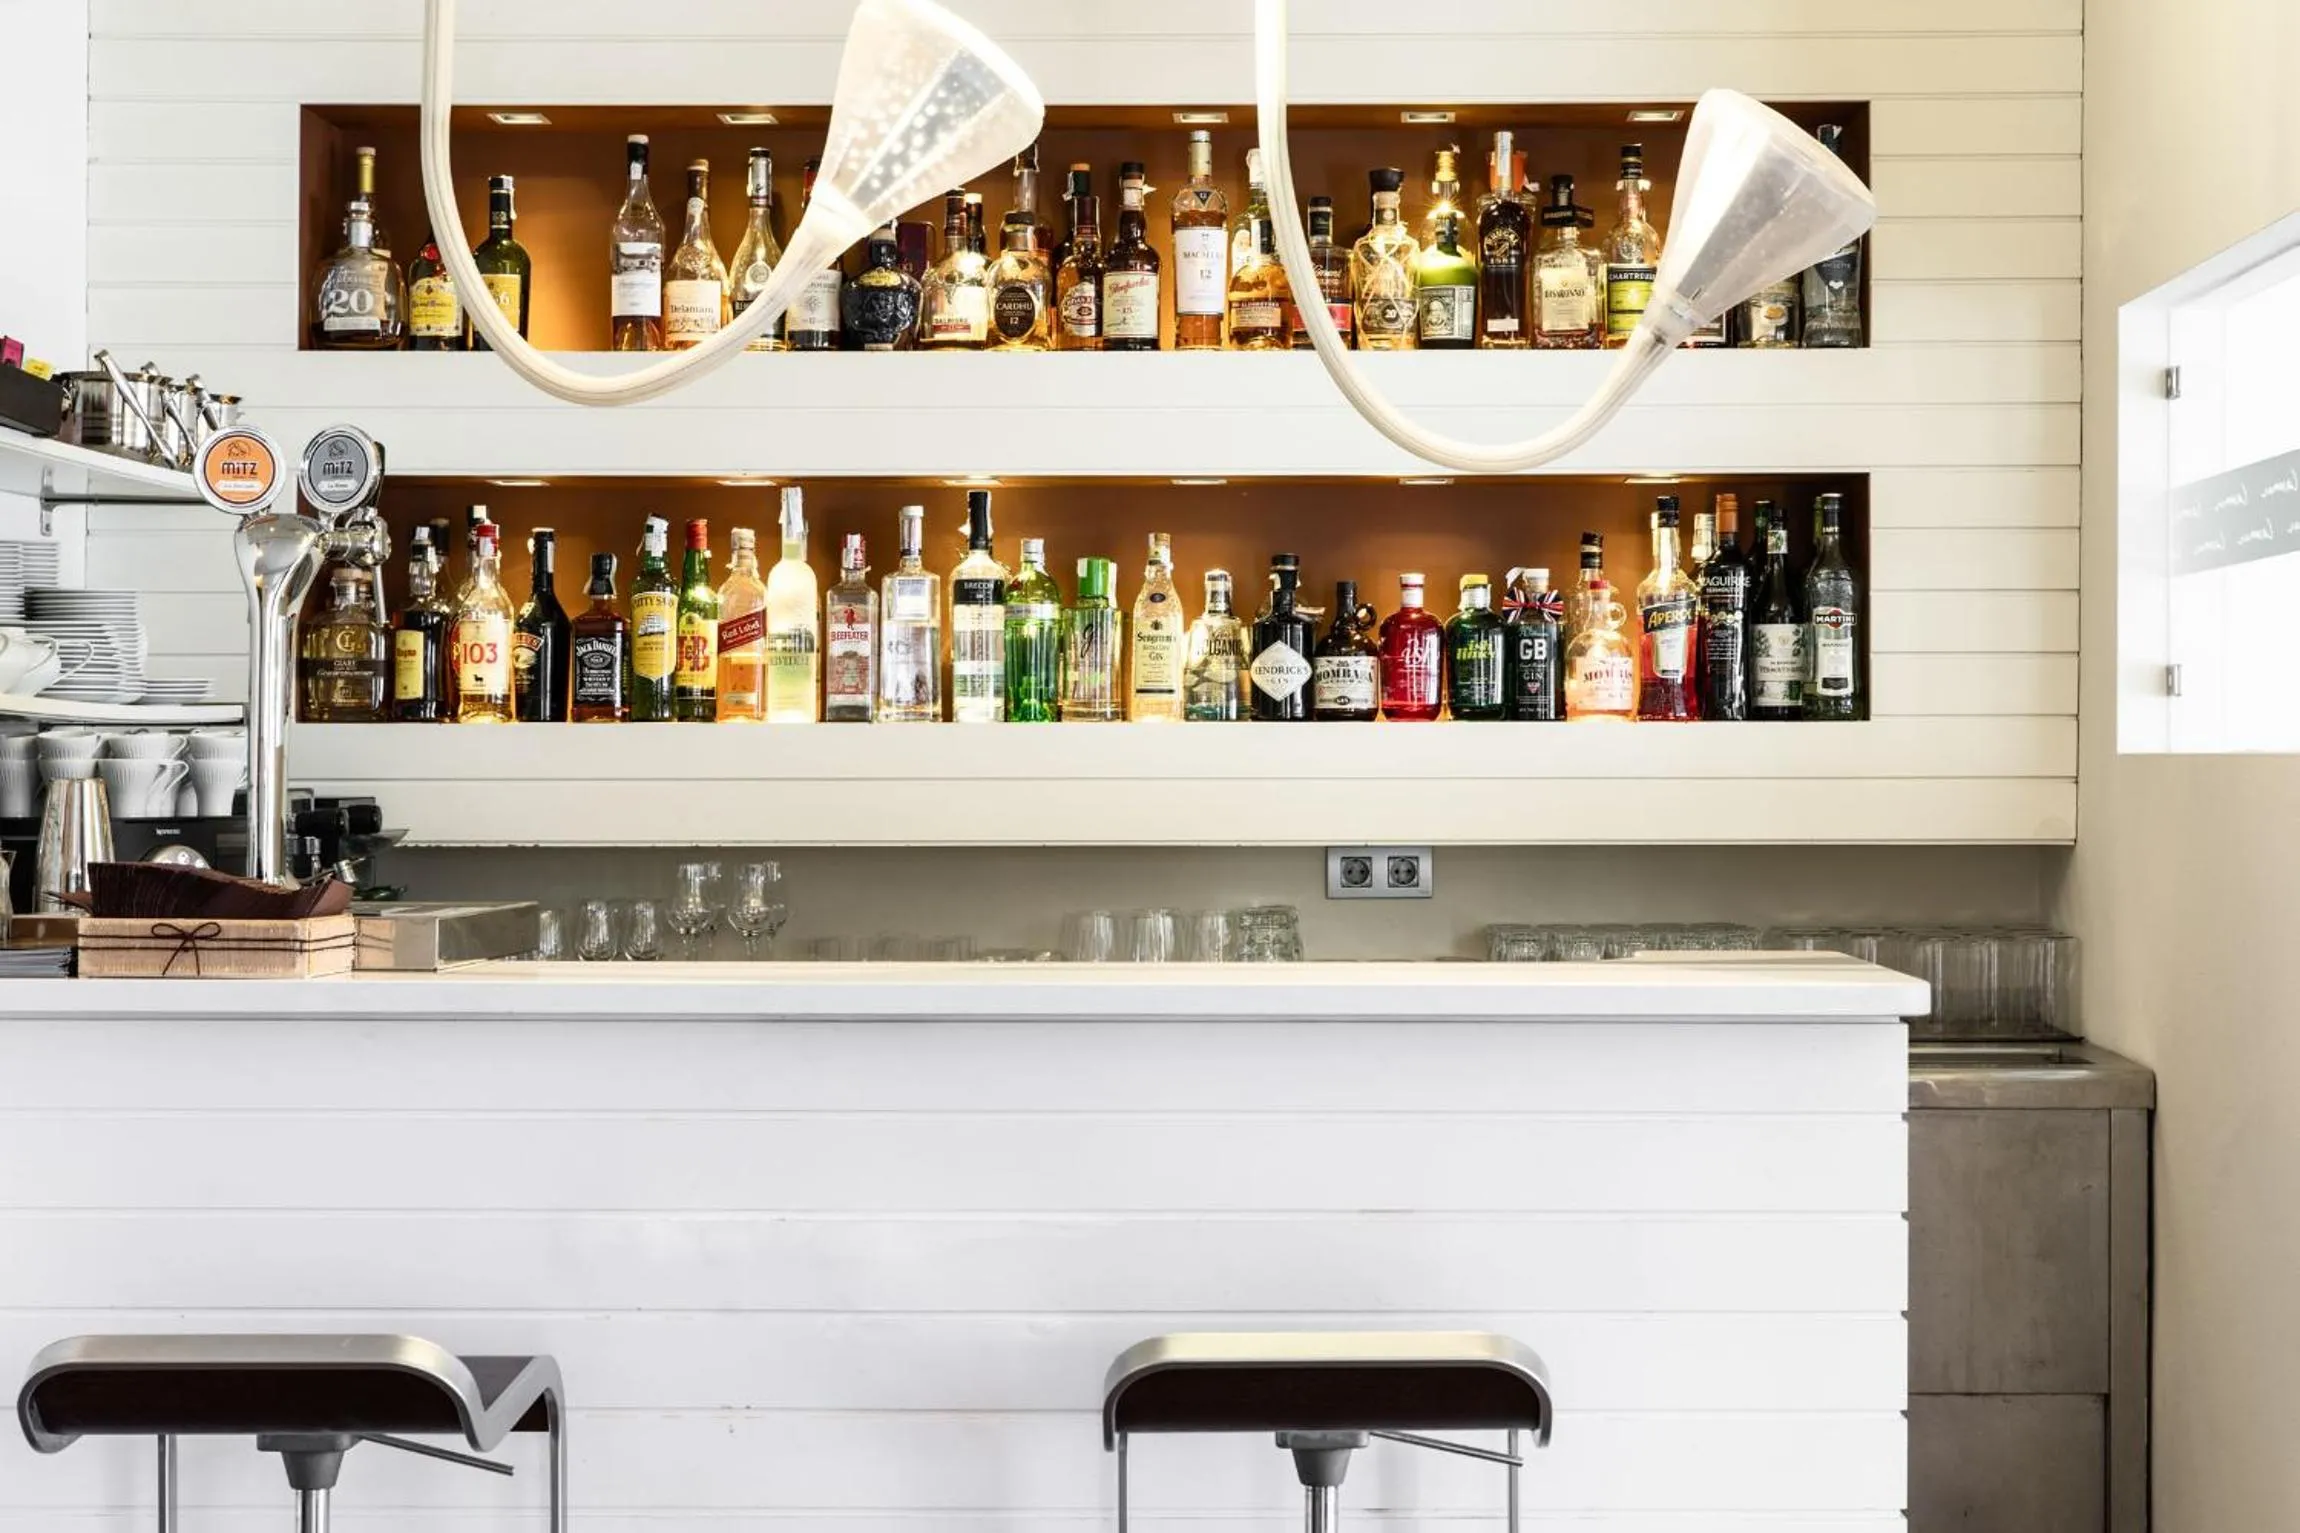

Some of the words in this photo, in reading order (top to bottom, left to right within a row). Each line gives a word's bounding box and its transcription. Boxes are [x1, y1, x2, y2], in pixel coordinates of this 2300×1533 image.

[328, 288, 375, 315] 20
[996, 302, 1034, 311] CARDHU
[1648, 608, 1693, 628] APEROL
[1816, 614, 1855, 624] MARTINI
[830, 630, 869, 642] BEEFEATER
[462, 642, 498, 664] 103
[576, 643, 593, 657] JACK
[1518, 638, 1548, 661] GB
[1315, 667, 1373, 683] MOMBAA
